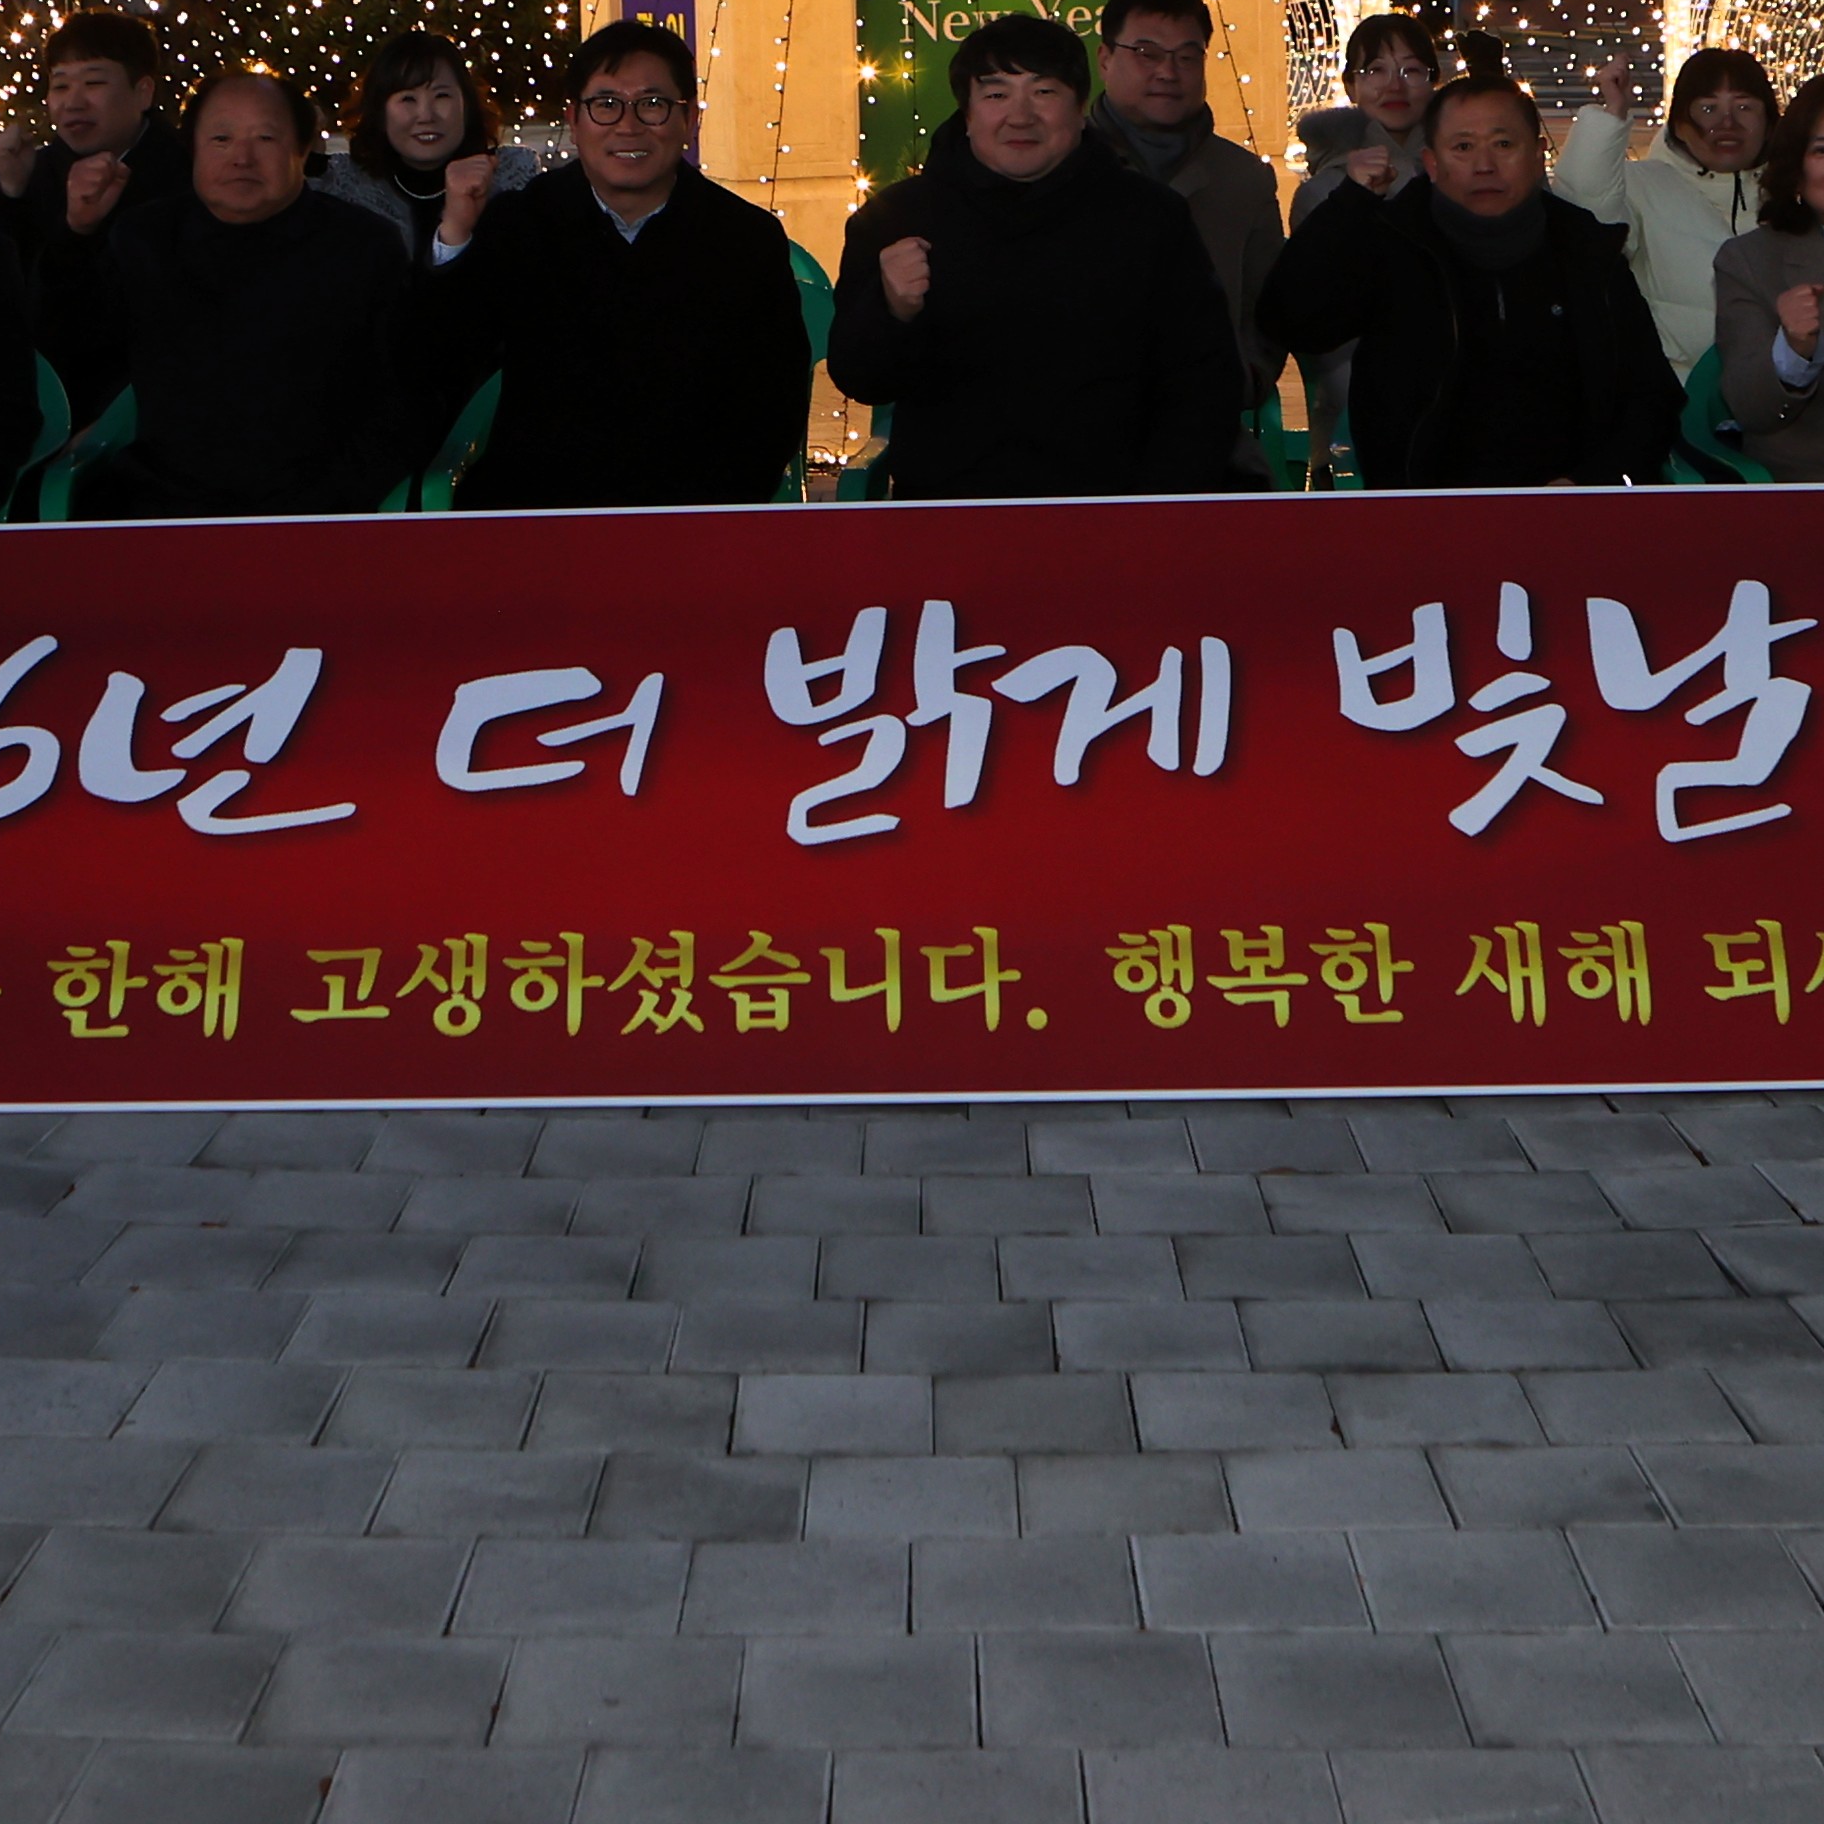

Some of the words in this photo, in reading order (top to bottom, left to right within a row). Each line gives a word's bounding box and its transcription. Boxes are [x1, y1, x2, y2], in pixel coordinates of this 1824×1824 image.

[435, 667, 664, 796] 더
[764, 598, 1231, 845] 밝게
[1333, 579, 1818, 842] 빛날
[47, 937, 244, 1041] 한해
[289, 926, 1048, 1037] 고생하셨습니다.
[1105, 922, 1415, 1029] 행복한
[1455, 920, 1652, 1027] 새해
